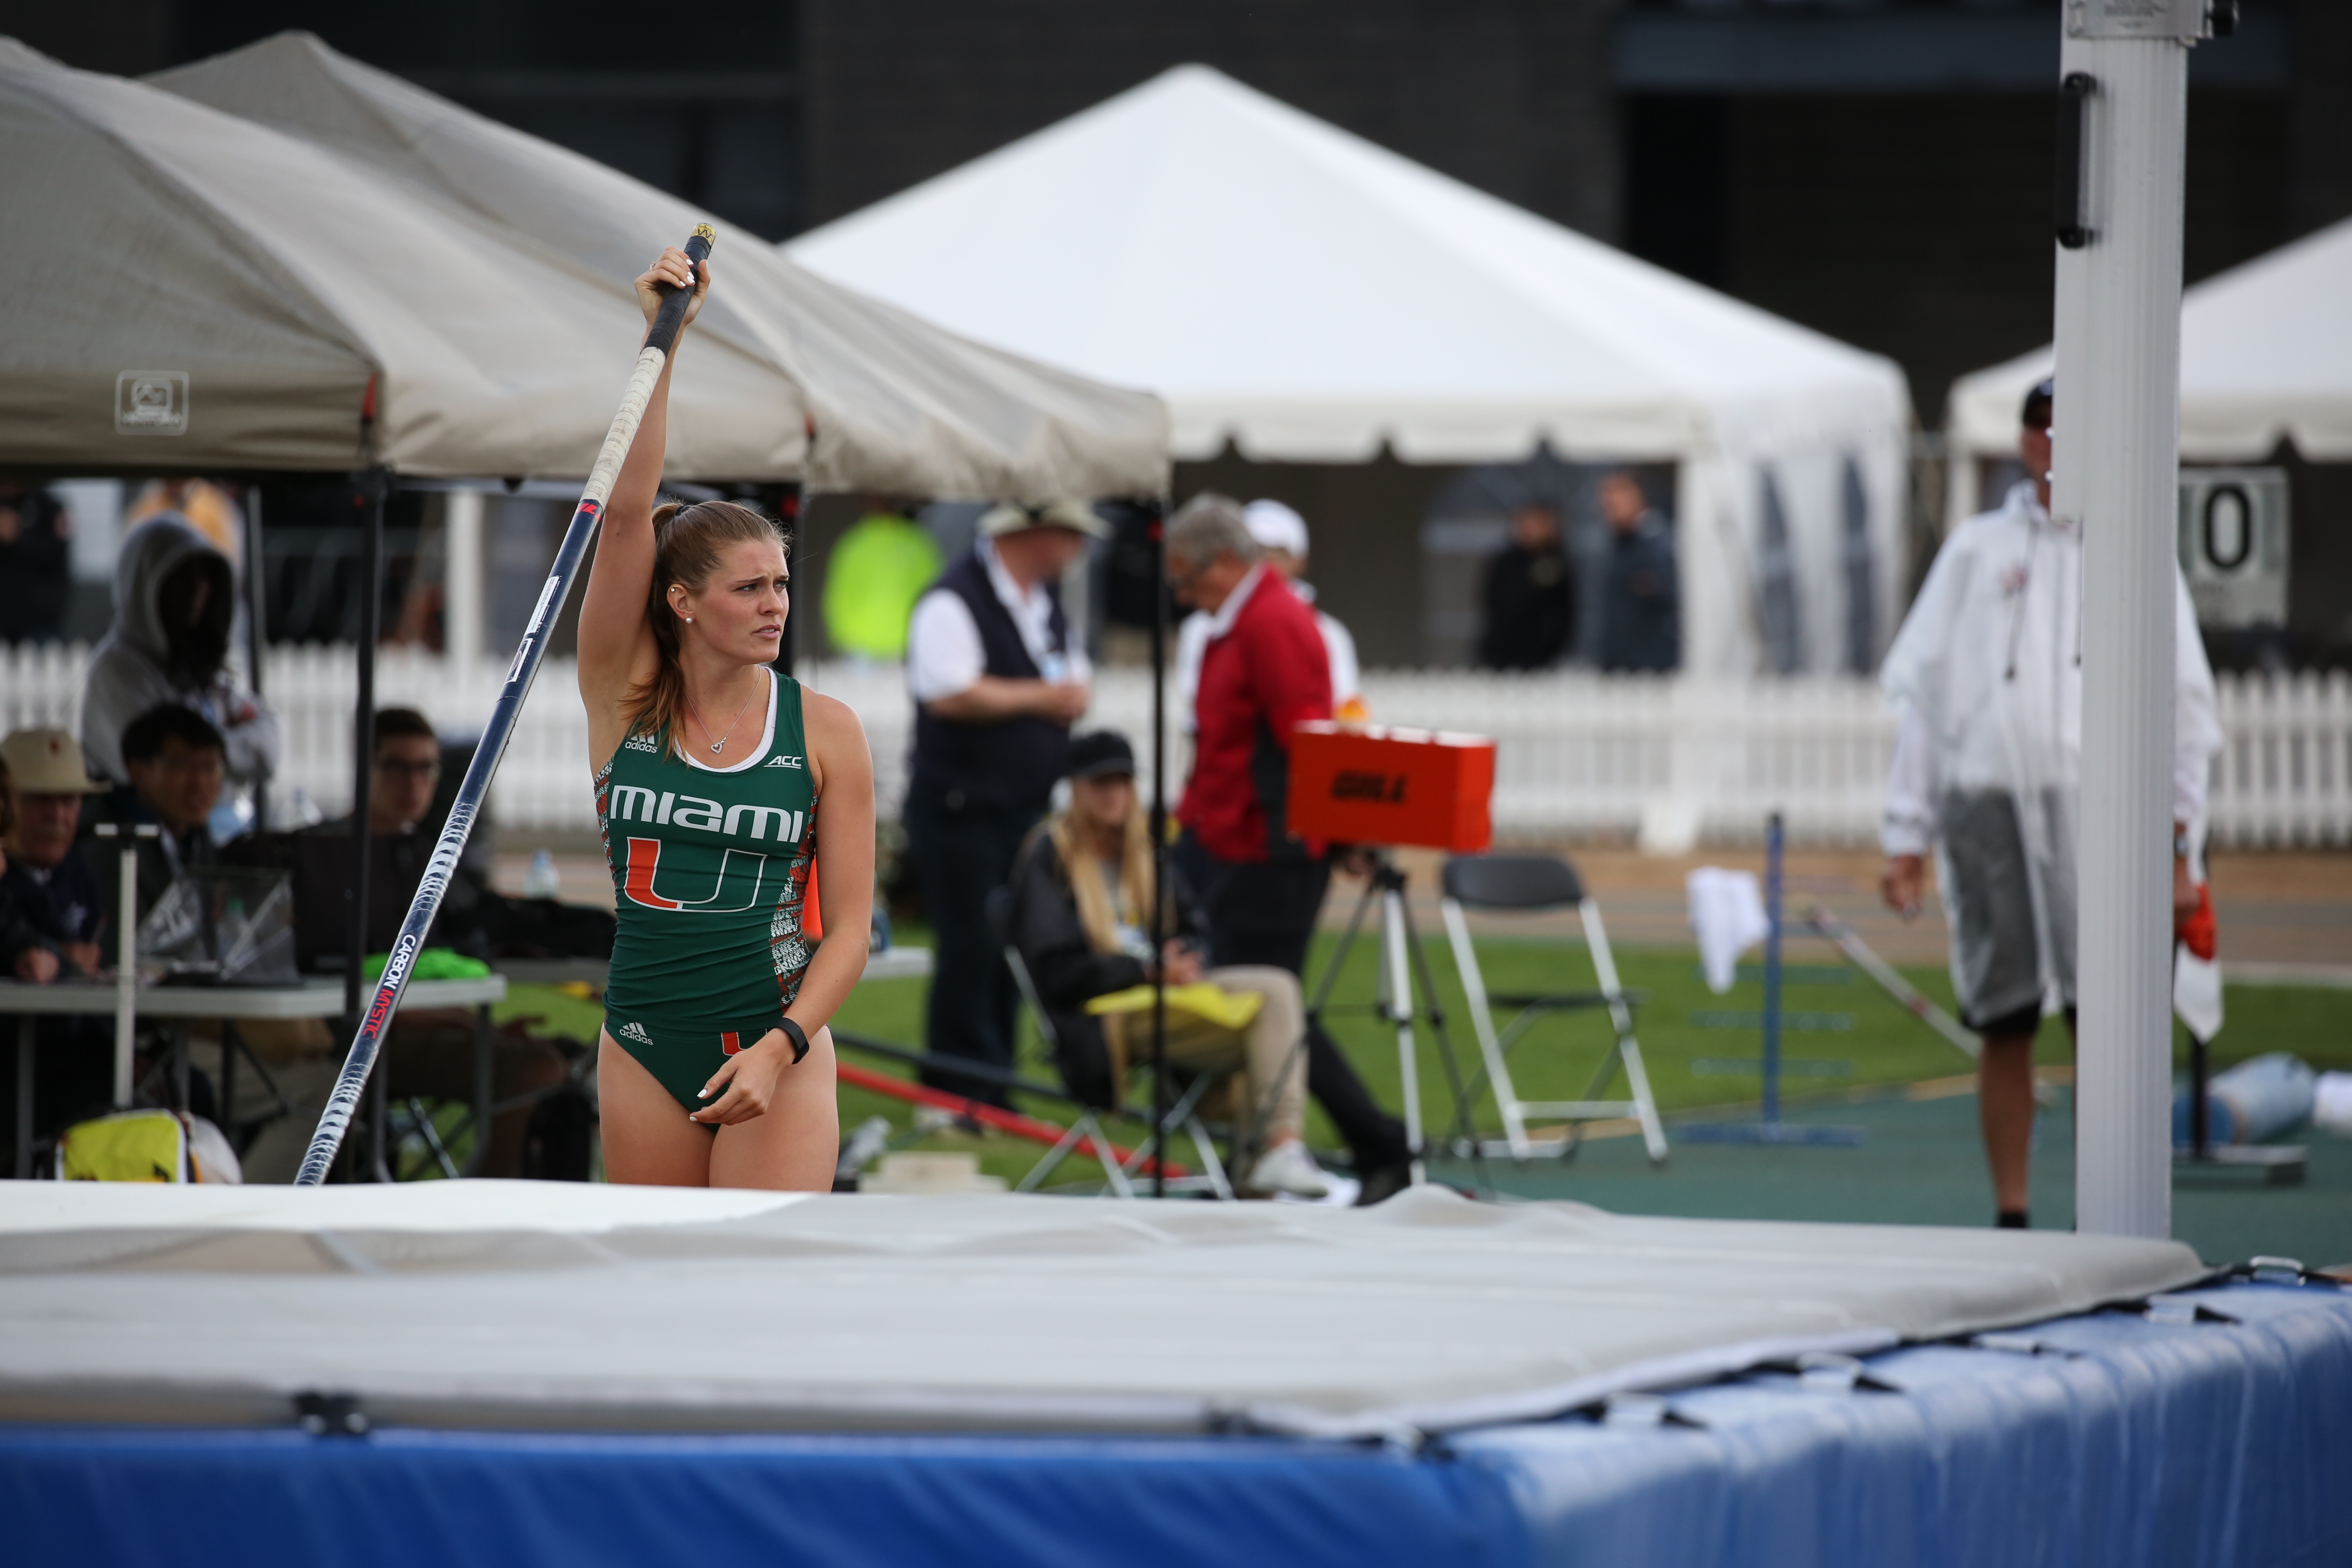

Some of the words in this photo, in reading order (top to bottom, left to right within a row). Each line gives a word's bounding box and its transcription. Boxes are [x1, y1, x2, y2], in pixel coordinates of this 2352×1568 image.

[625, 741, 658, 753] adidas
[767, 755, 803, 767] ACC
[623, 836, 768, 913] U
[383, 934, 416, 990] CARBON
[362, 989, 394, 1039] MYSTIC
[619, 1028, 653, 1045] adidas
